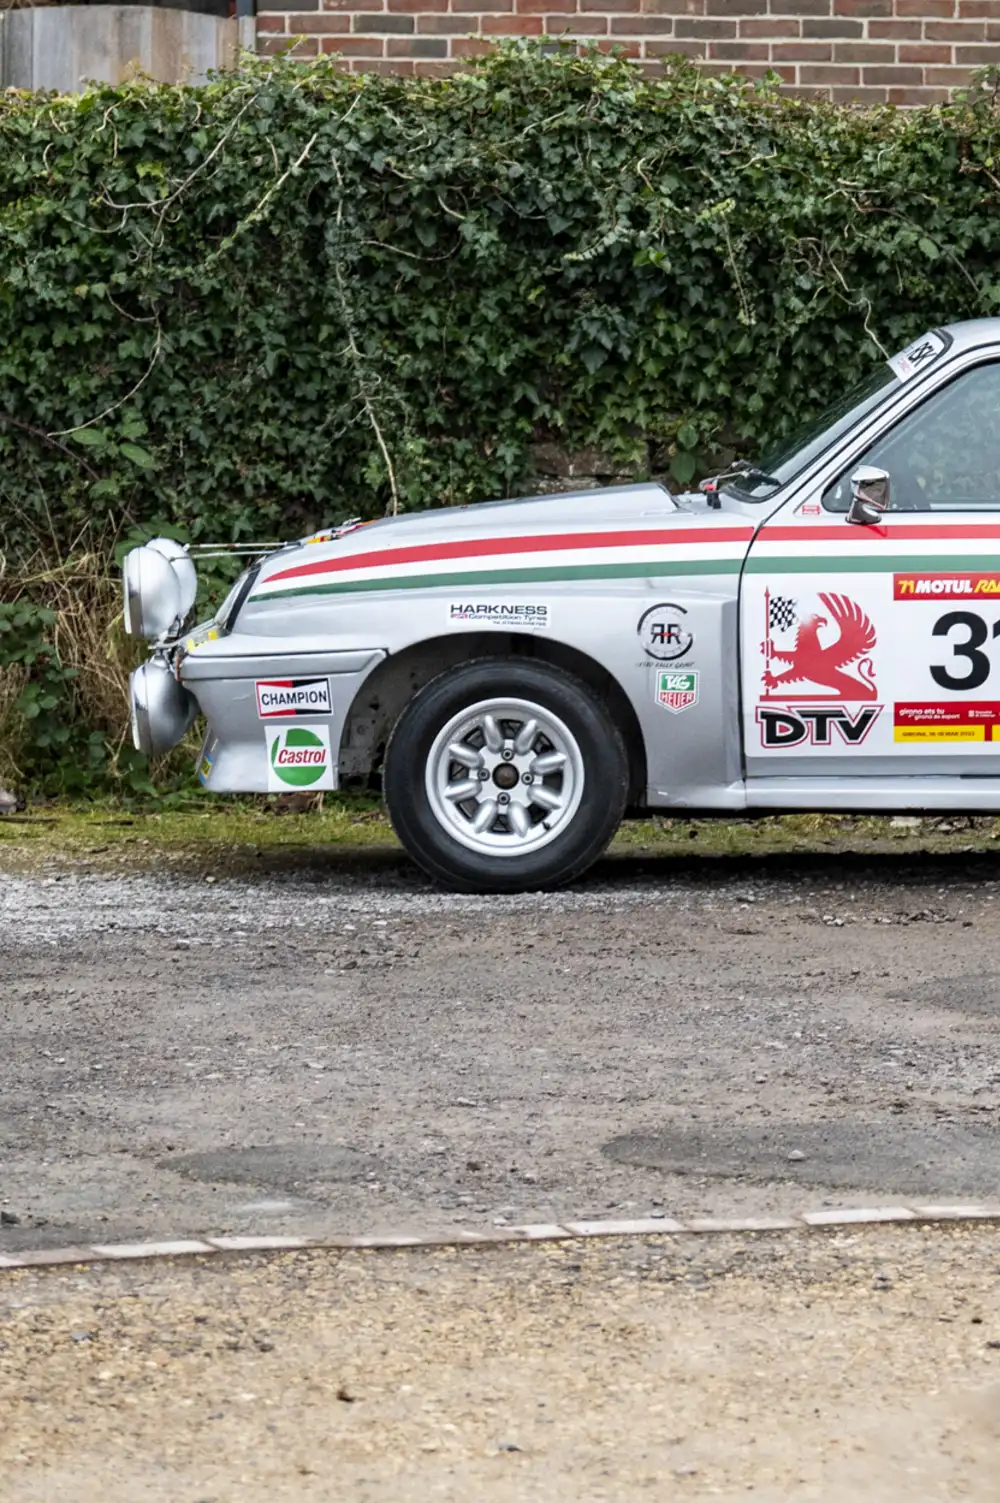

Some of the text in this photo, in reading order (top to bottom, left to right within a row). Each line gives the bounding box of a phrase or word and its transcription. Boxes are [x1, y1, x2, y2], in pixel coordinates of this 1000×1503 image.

[915, 579, 973, 594] MOTUL
[450, 604, 548, 615] HARKNESS
[664, 675, 691, 690] TAG
[261, 690, 327, 706] CHAMPION
[659, 691, 695, 709] HEUER
[757, 706, 882, 747] DTV
[278, 749, 327, 764] Castrol
